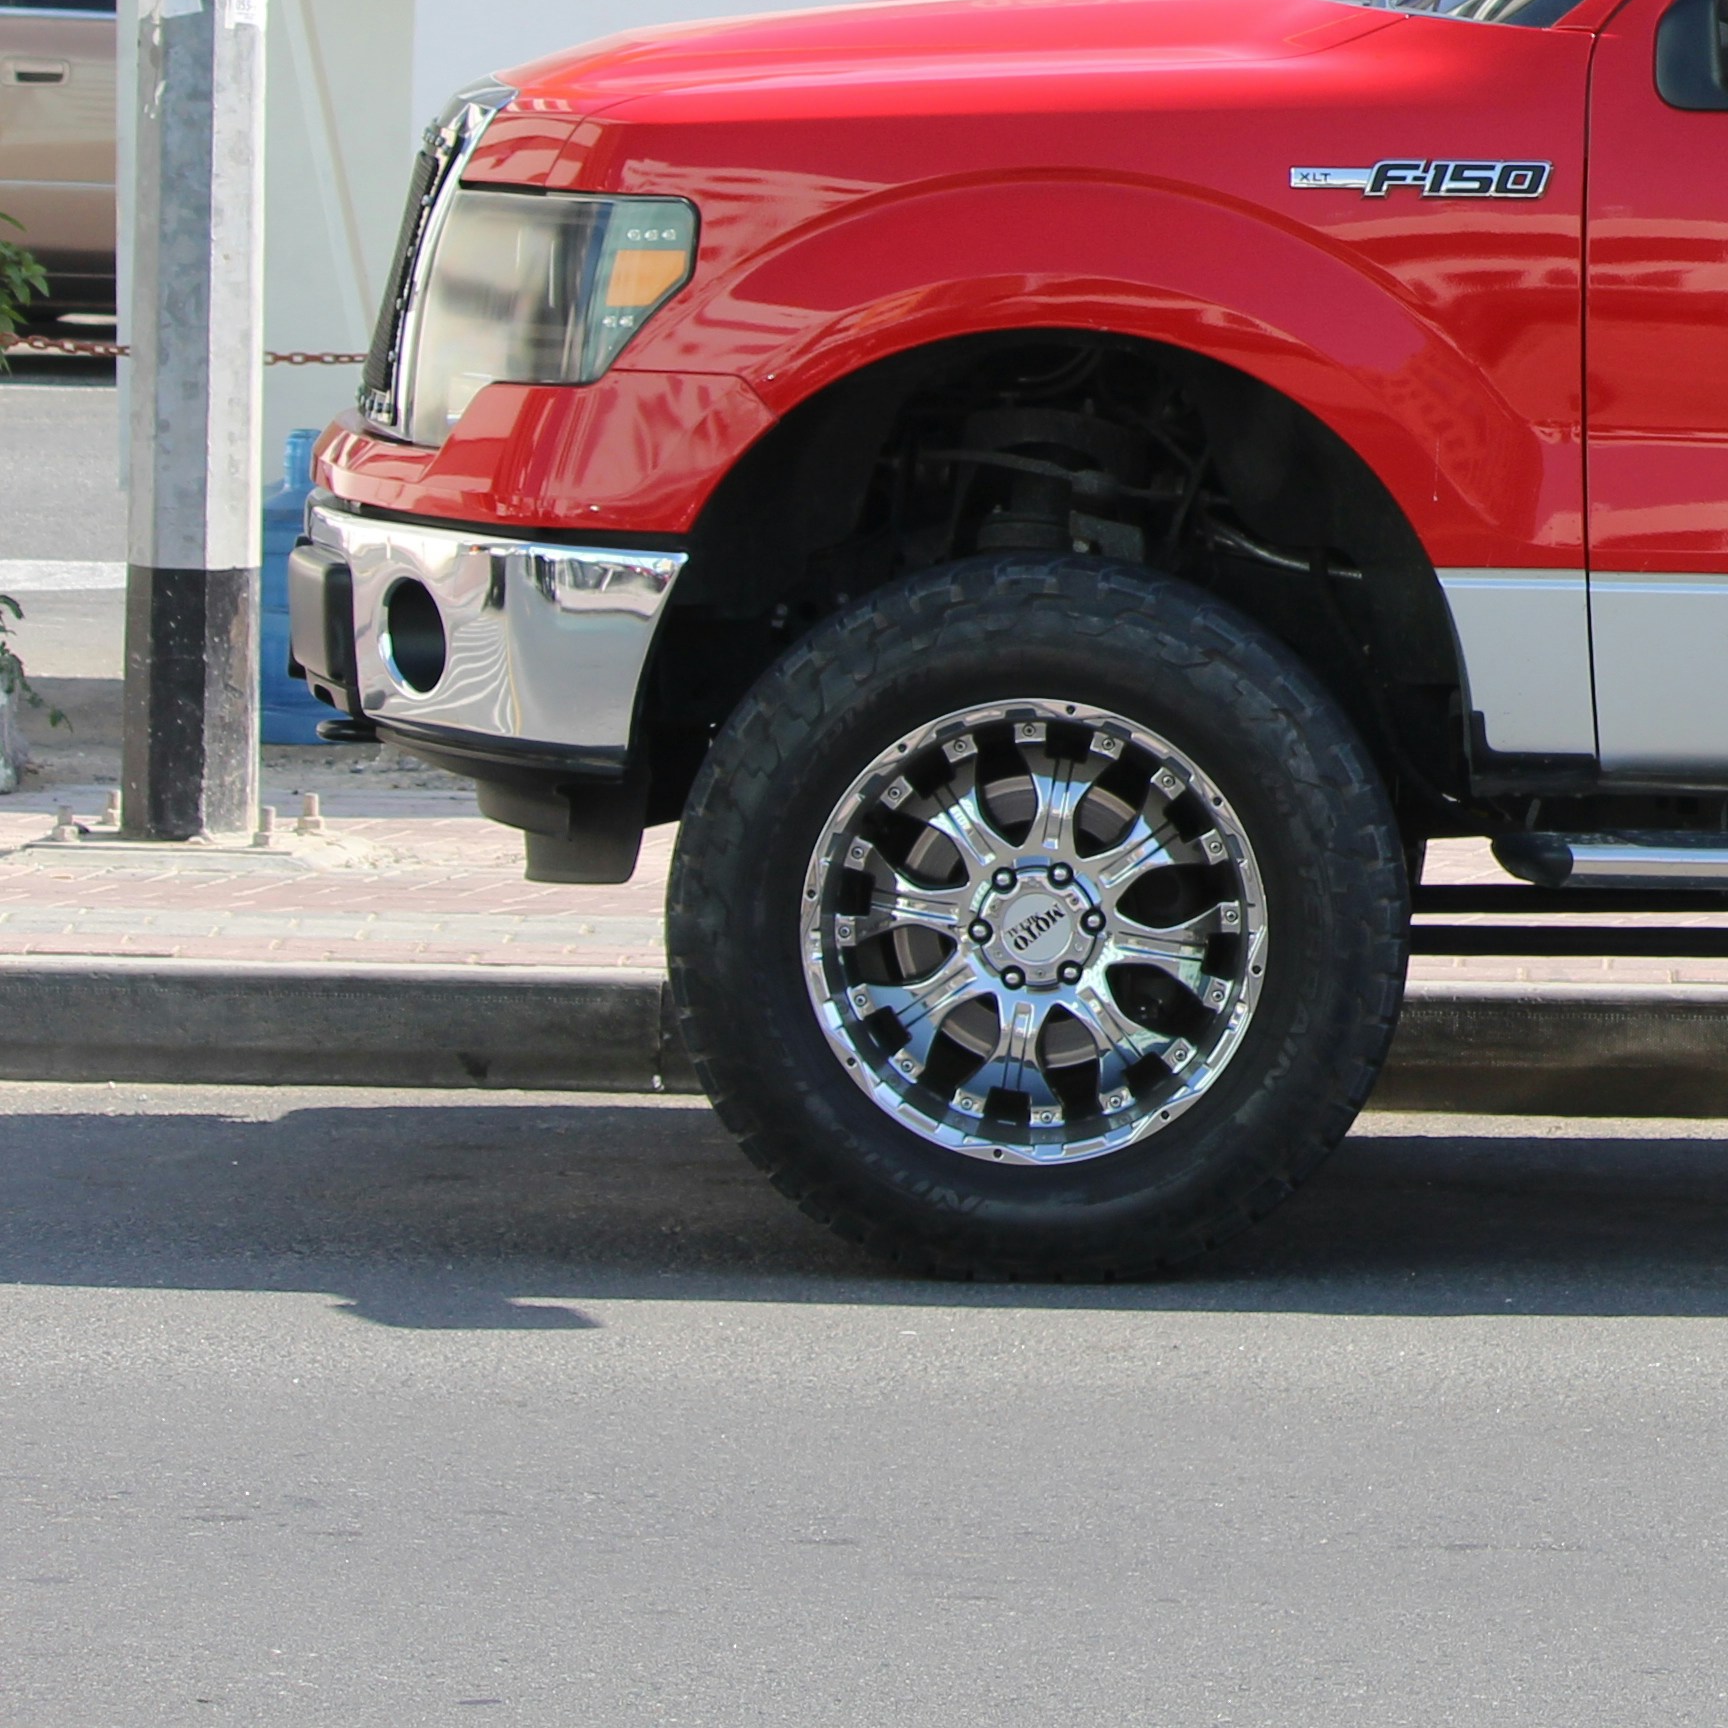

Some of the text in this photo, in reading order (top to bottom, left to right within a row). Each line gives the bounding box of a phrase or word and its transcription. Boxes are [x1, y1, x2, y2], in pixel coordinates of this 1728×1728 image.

[1300, 172, 1331, 183] XLT
[1365, 161, 1551, 196] F-150
[1013, 903, 1065, 950] MOTO
